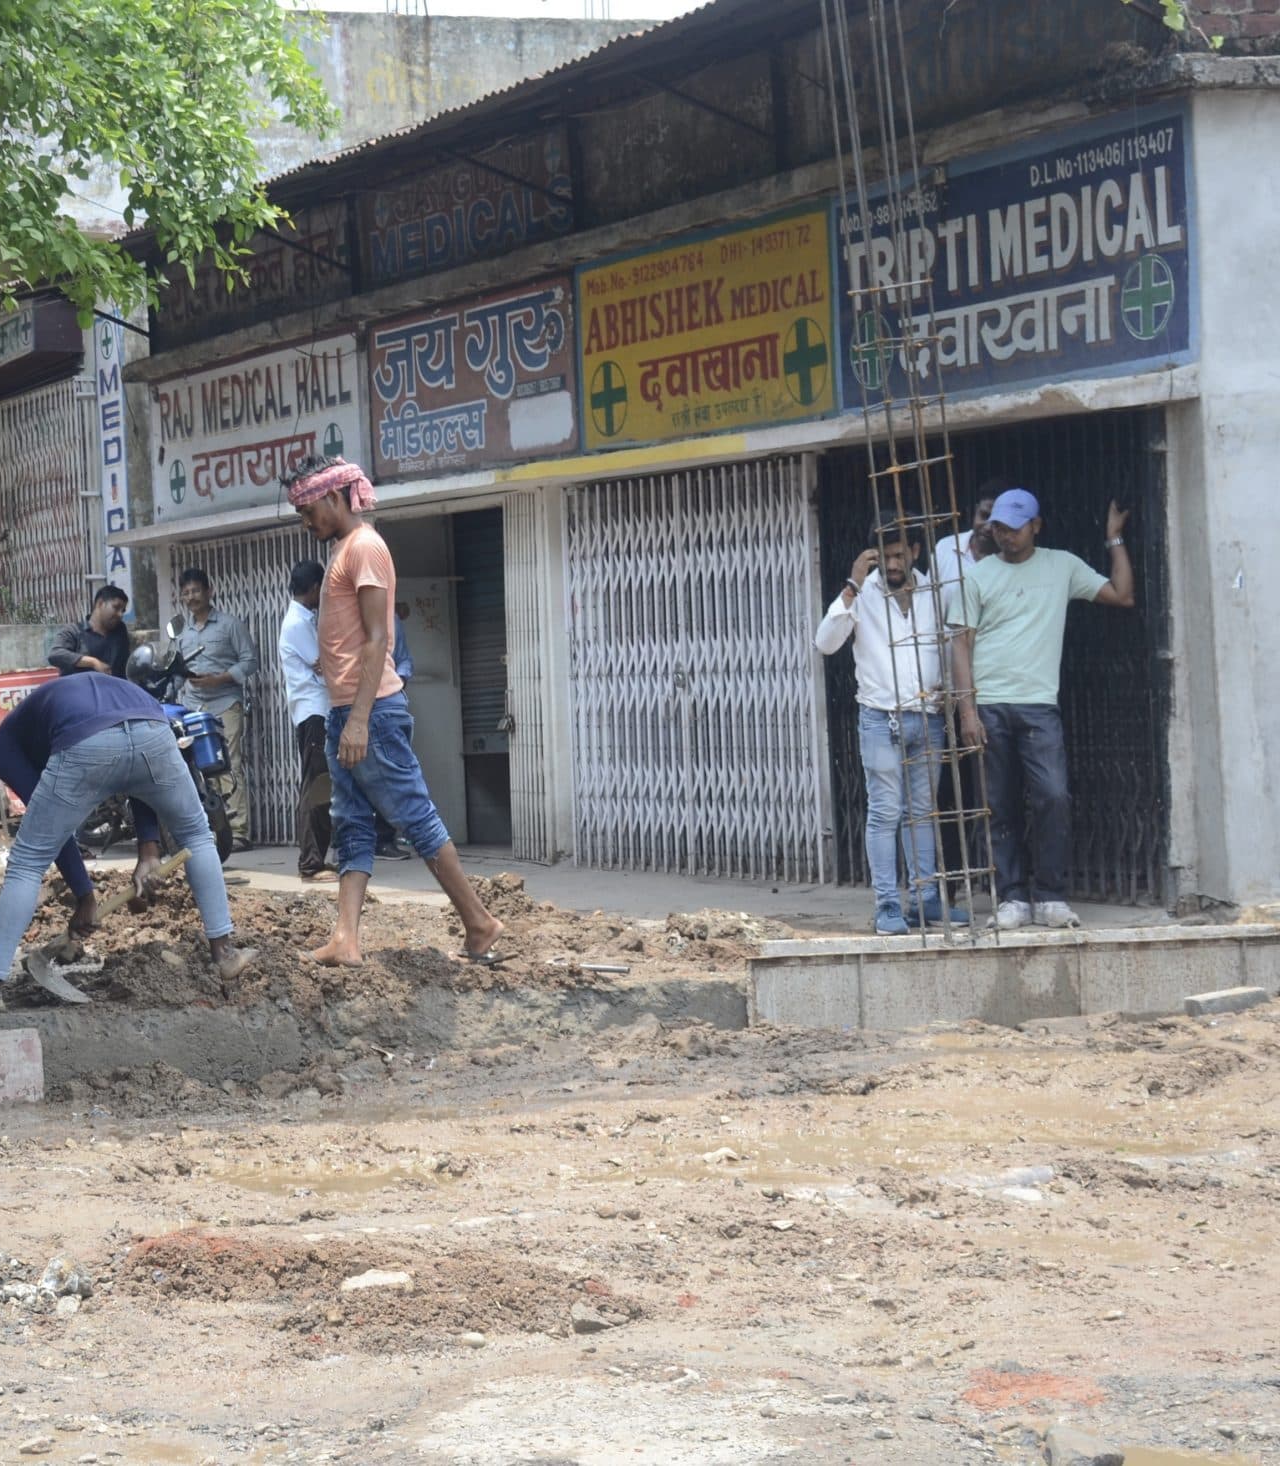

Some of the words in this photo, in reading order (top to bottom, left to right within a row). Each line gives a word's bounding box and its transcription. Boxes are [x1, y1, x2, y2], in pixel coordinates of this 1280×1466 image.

[369, 174, 574, 280] MEDICALS
[987, 165, 1182, 283] MEDICAL
[373, 312, 460, 405] जय
[584, 277, 726, 356] ABHISHEK
[730, 269, 825, 322] MEDICAL
[157, 388, 195, 443] RAJ
[200, 363, 292, 437] MEDICAL
[294, 347, 353, 419] HALL
[638, 332, 781, 413] दवाखाना
[98, 363, 128, 588] MEDICA
